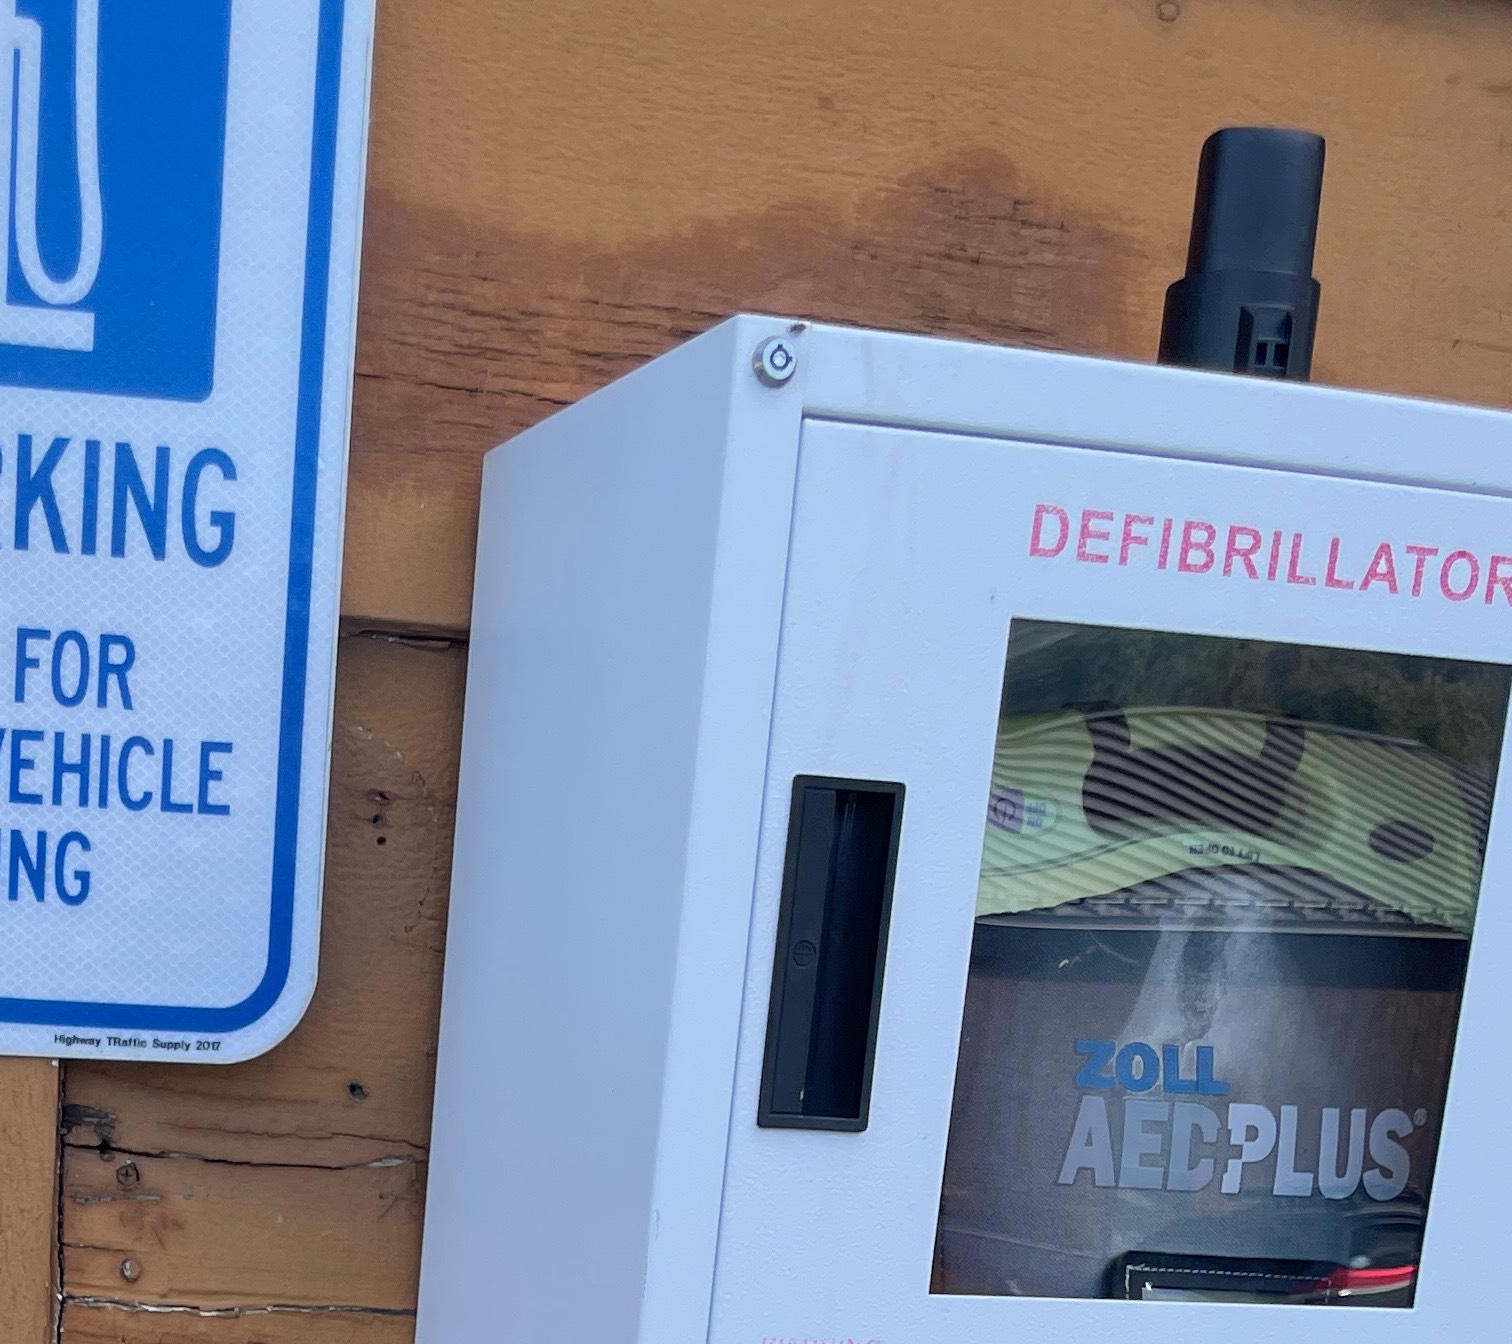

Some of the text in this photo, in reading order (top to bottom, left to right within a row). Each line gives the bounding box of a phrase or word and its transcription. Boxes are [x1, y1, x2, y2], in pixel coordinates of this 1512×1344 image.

[14, 628, 137, 711] FOR
[54, 1034, 101, 1048] Highway
[152, 1038, 191, 1052] Supply
[1074, 1039, 1230, 1096] ZOLL
